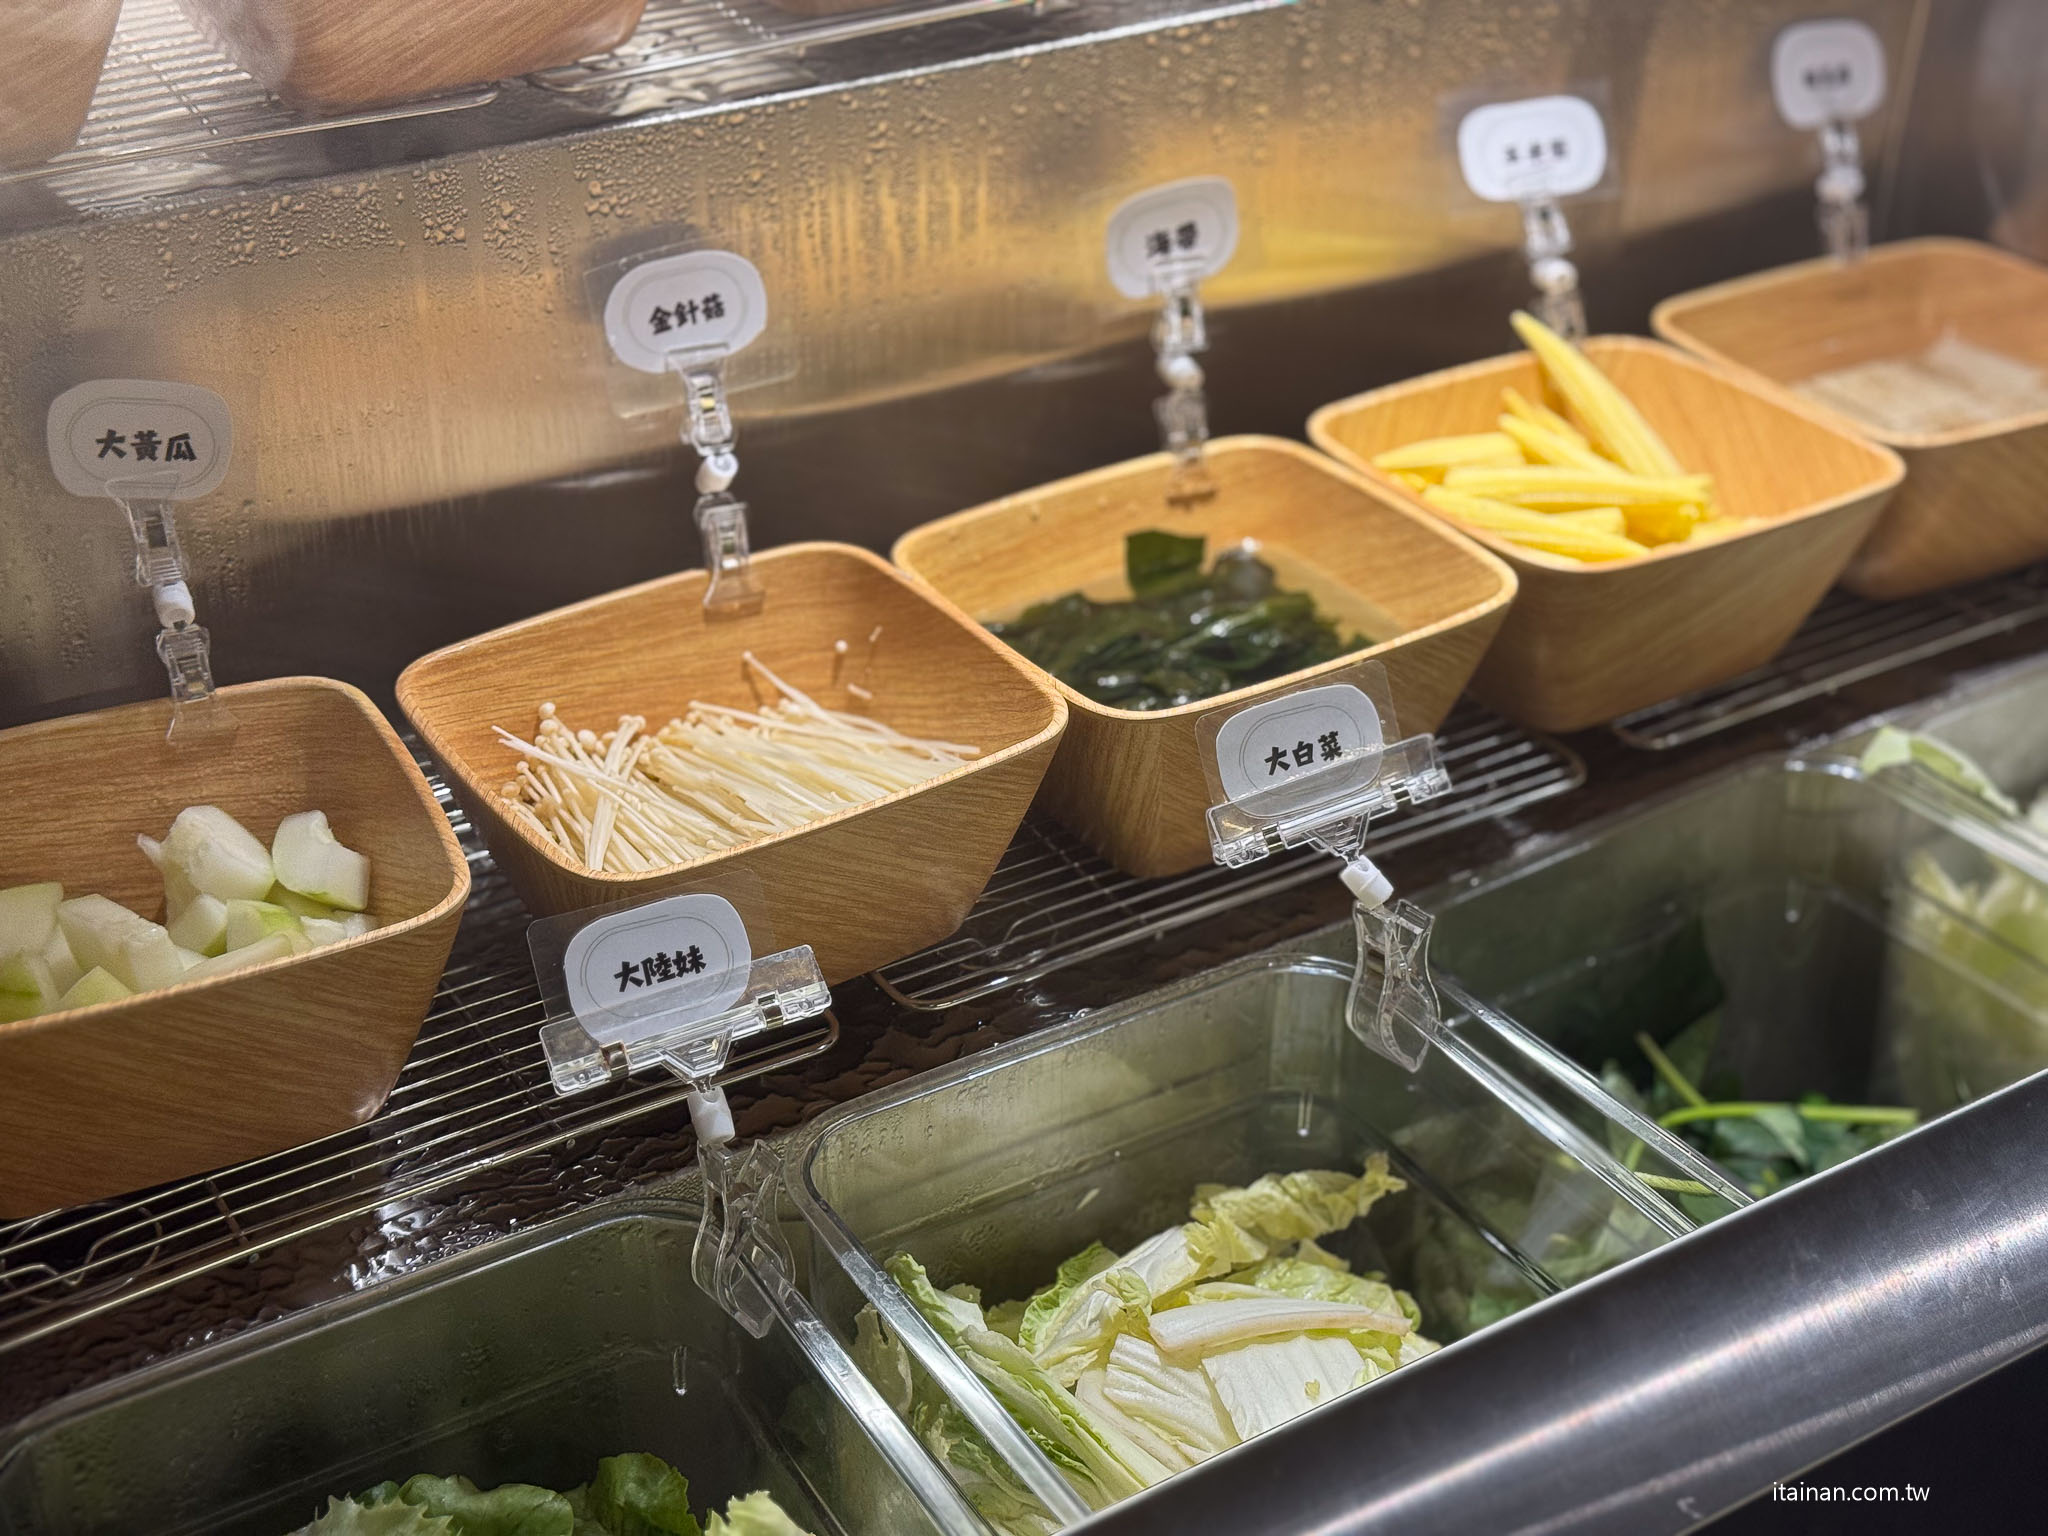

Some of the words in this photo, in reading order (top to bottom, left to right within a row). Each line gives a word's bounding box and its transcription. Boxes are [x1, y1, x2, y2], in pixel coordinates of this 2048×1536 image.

[649, 292, 725, 335] 金針菇
[1264, 730, 1343, 776] 大白菜
[613, 944, 707, 993] 大陸妹
